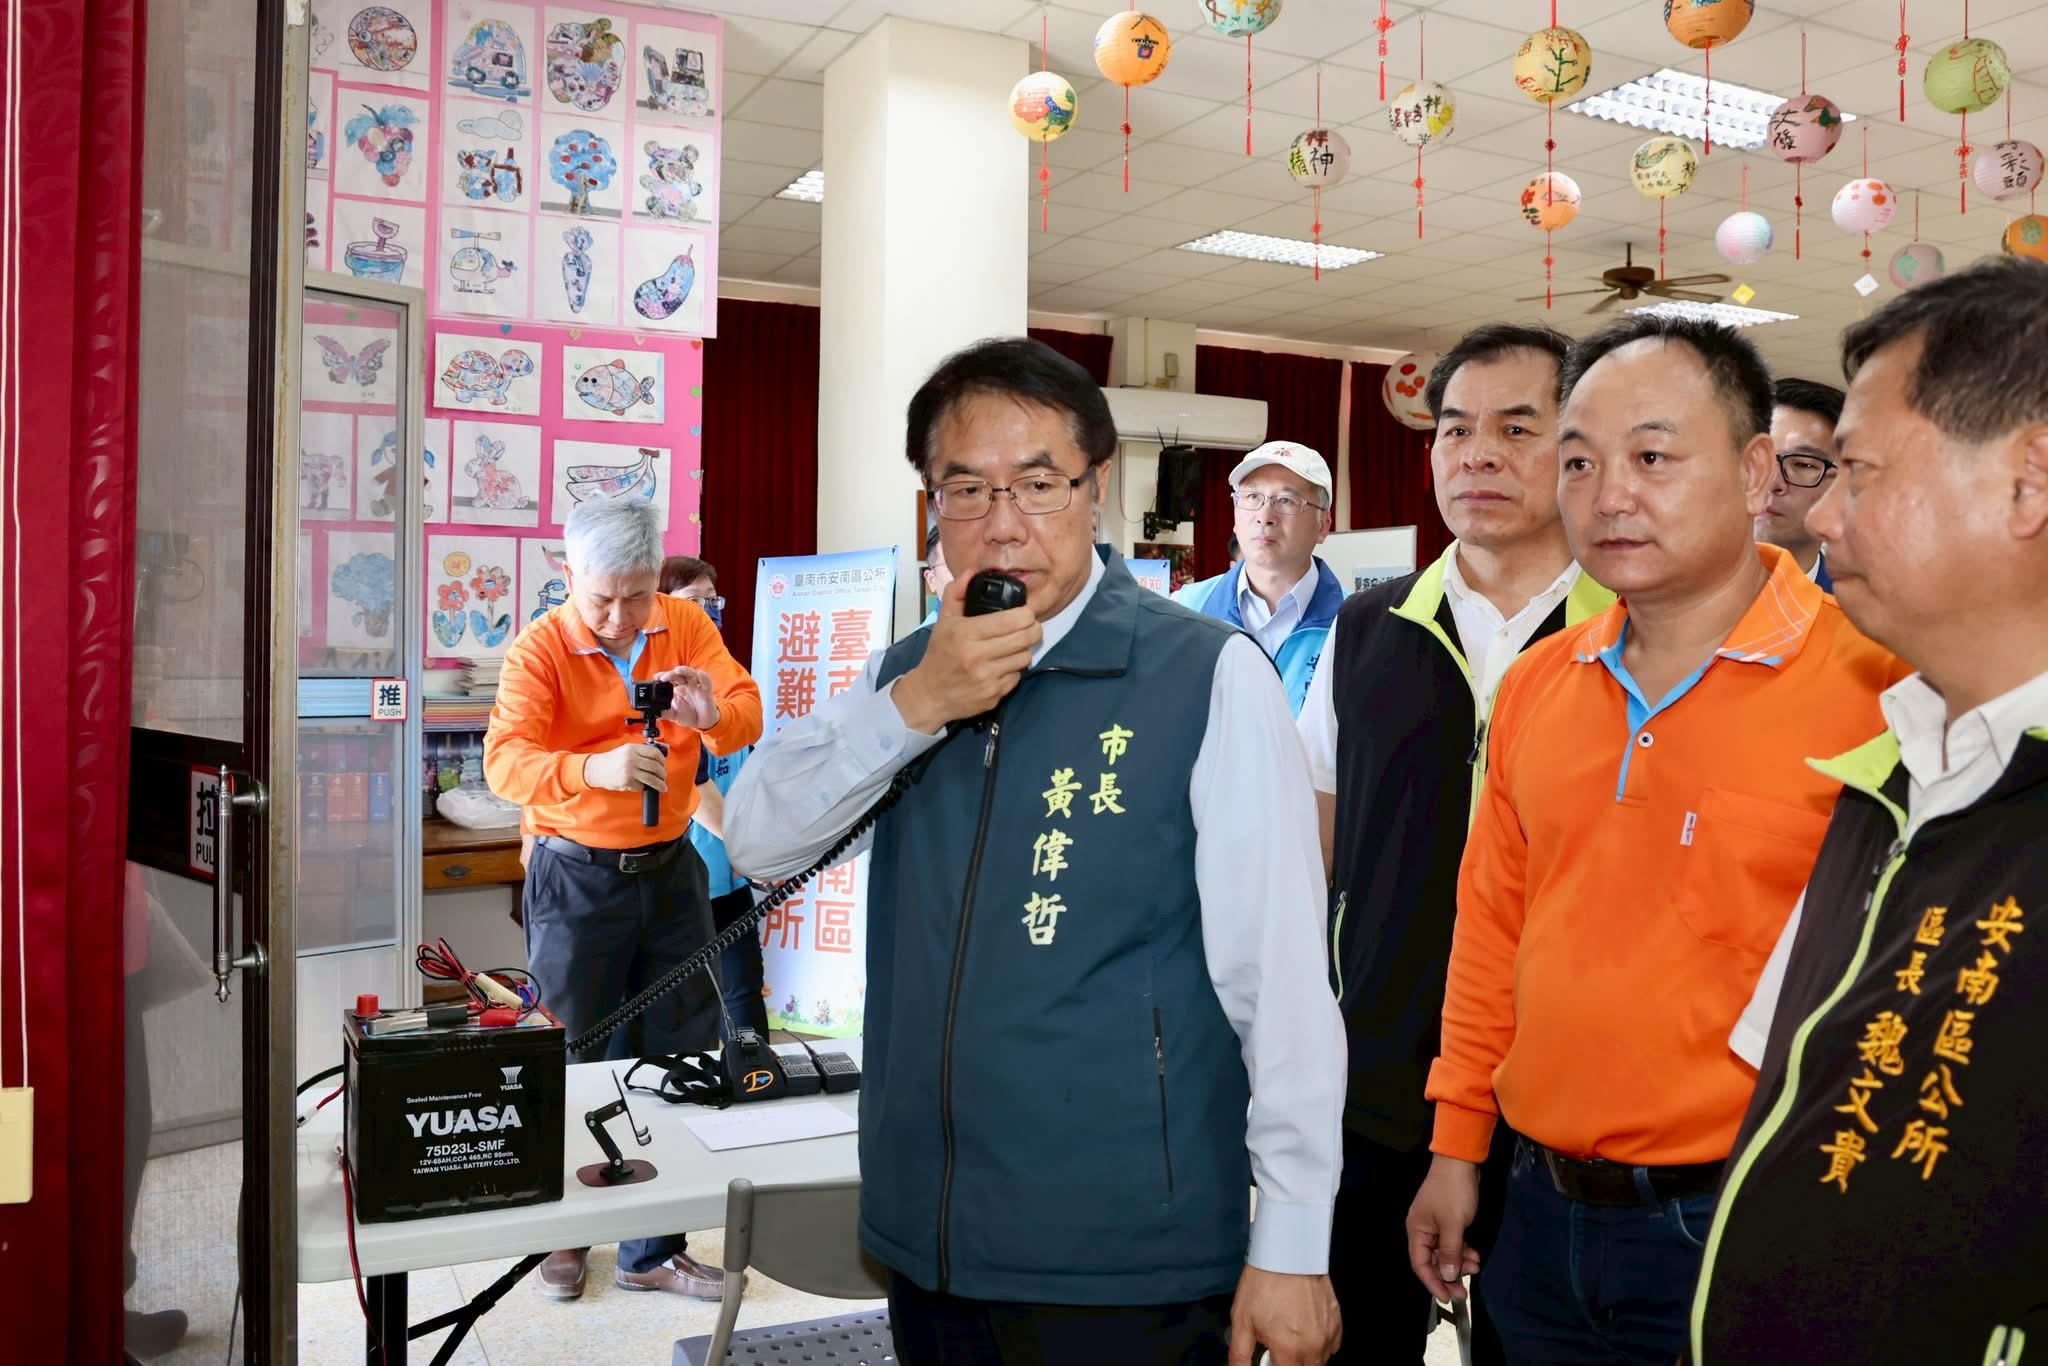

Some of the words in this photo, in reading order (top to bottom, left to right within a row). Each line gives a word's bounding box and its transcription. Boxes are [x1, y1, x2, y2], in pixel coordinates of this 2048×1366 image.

[794, 567, 887, 588] 臺南市安南區公所
[379, 684, 401, 706] 推
[378, 708, 402, 717] PUSH
[1089, 723, 1134, 815] 市長
[196, 781, 217, 837] 拉
[195, 843, 214, 866] PUL
[1021, 767, 1082, 946] 黃偉哲
[1895, 906, 1948, 996] 區長
[1891, 895, 2024, 1181] 安南區公所
[500, 1083, 523, 1091] YUASA
[406, 1096, 428, 1104] Sealed
[428, 1094, 468, 1103] Maintenance
[1819, 1010, 1909, 1194] 魏文貴
[405, 1104, 523, 1138] YUASA
[425, 1139, 506, 1158] 75D23L-SMF
[412, 1165, 439, 1175] TAIWAN
[439, 1163, 463, 1172] YUASA
[463, 1160, 493, 1170] BATTERY
